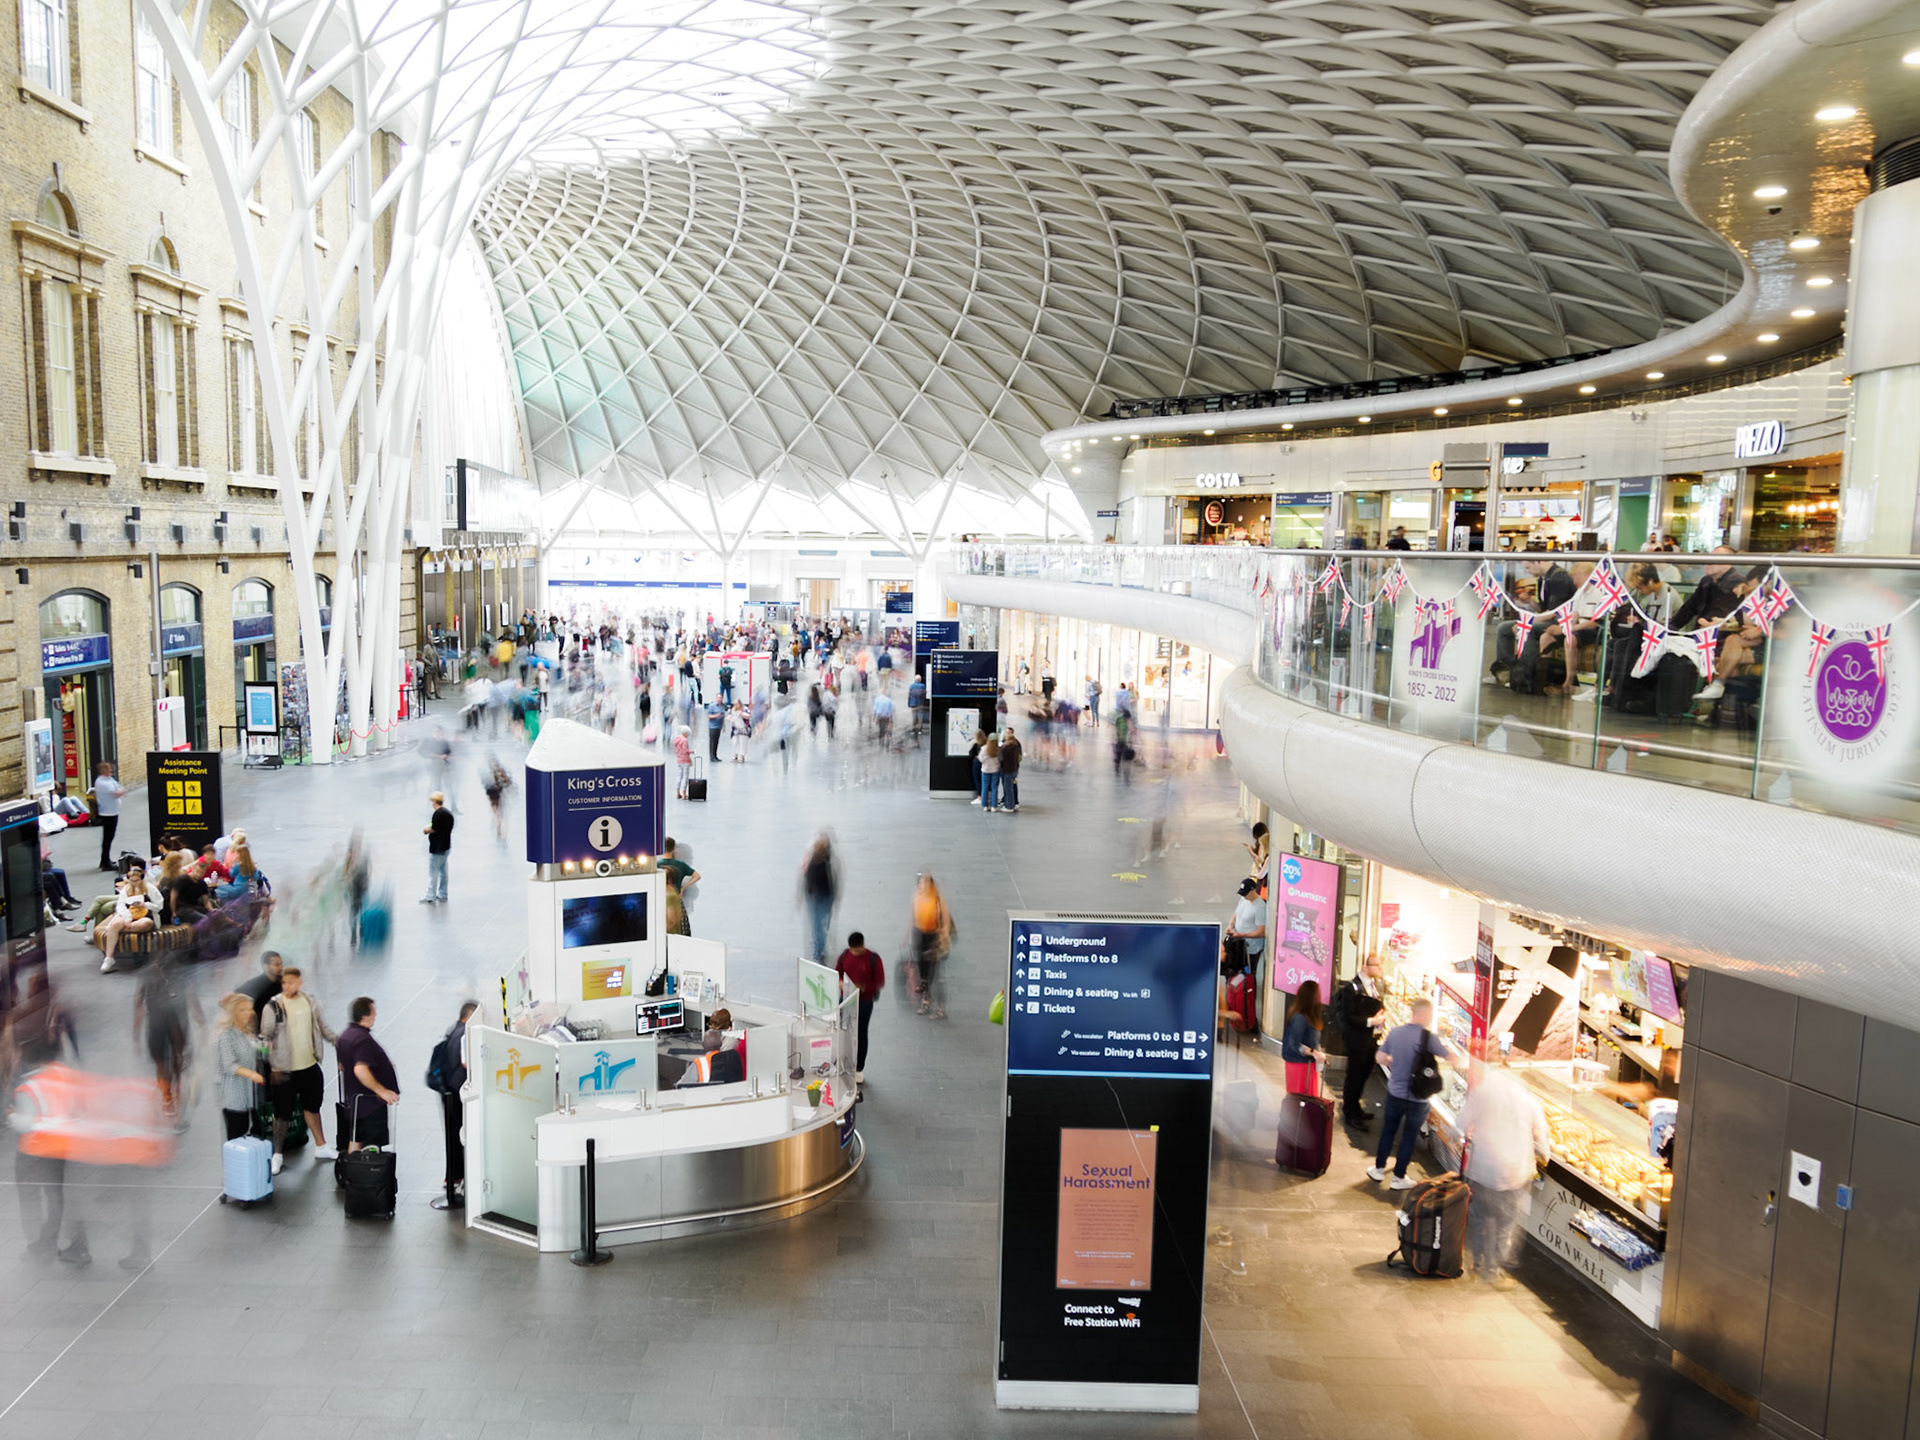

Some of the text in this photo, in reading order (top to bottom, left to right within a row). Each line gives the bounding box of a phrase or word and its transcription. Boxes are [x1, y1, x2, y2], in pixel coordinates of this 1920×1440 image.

[1735, 421, 1781, 458] PREZZO
[1196, 472, 1241, 489] COSTA
[1423, 671, 1438, 679] CROSS
[1438, 673, 1458, 682] STATION
[1407, 682, 1426, 697] 1852
[1434, 686, 1456, 702] 2022
[158, 768, 188, 776] Meeting
[568, 776, 642, 791] King's Cross
[568, 795, 642, 805] CUSTOMER INFORMATION
[1282, 864, 1302, 877] 20%
[1294, 889, 1327, 904] PLANTASTIC
[1046, 936, 1106, 947] Underground
[1045, 953, 1089, 964] Platforms
[1091, 954, 1098, 963] 0
[1112, 956, 1118, 964] 8
[1044, 970, 1067, 979] Taxis
[1286, 968, 1297, 985] So
[1044, 986, 1074, 998] Dining
[1076, 988, 1084, 996] &
[1085, 989, 1119, 1000] seating
[1043, 1004, 1076, 1014] Tickets
[1107, 1031, 1151, 1041] Platforms
[1153, 1032, 1160, 1041] 0
[1161, 1033, 1172, 1041] to
[1174, 1033, 1180, 1042] 8
[1104, 1048, 1134, 1060] Dining
[1136, 1050, 1144, 1058] &
[1146, 1050, 1179, 1060] seating
[1082, 1164, 1132, 1177] Sexual
[1064, 1176, 1150, 1189] Harassment
[1558, 1190, 1588, 1212] MAD
[1538, 1223, 1606, 1284] CORNWALL
[1064, 1304, 1115, 1314] Connect to
[1064, 1318, 1140, 1328] Free Station WiFi
